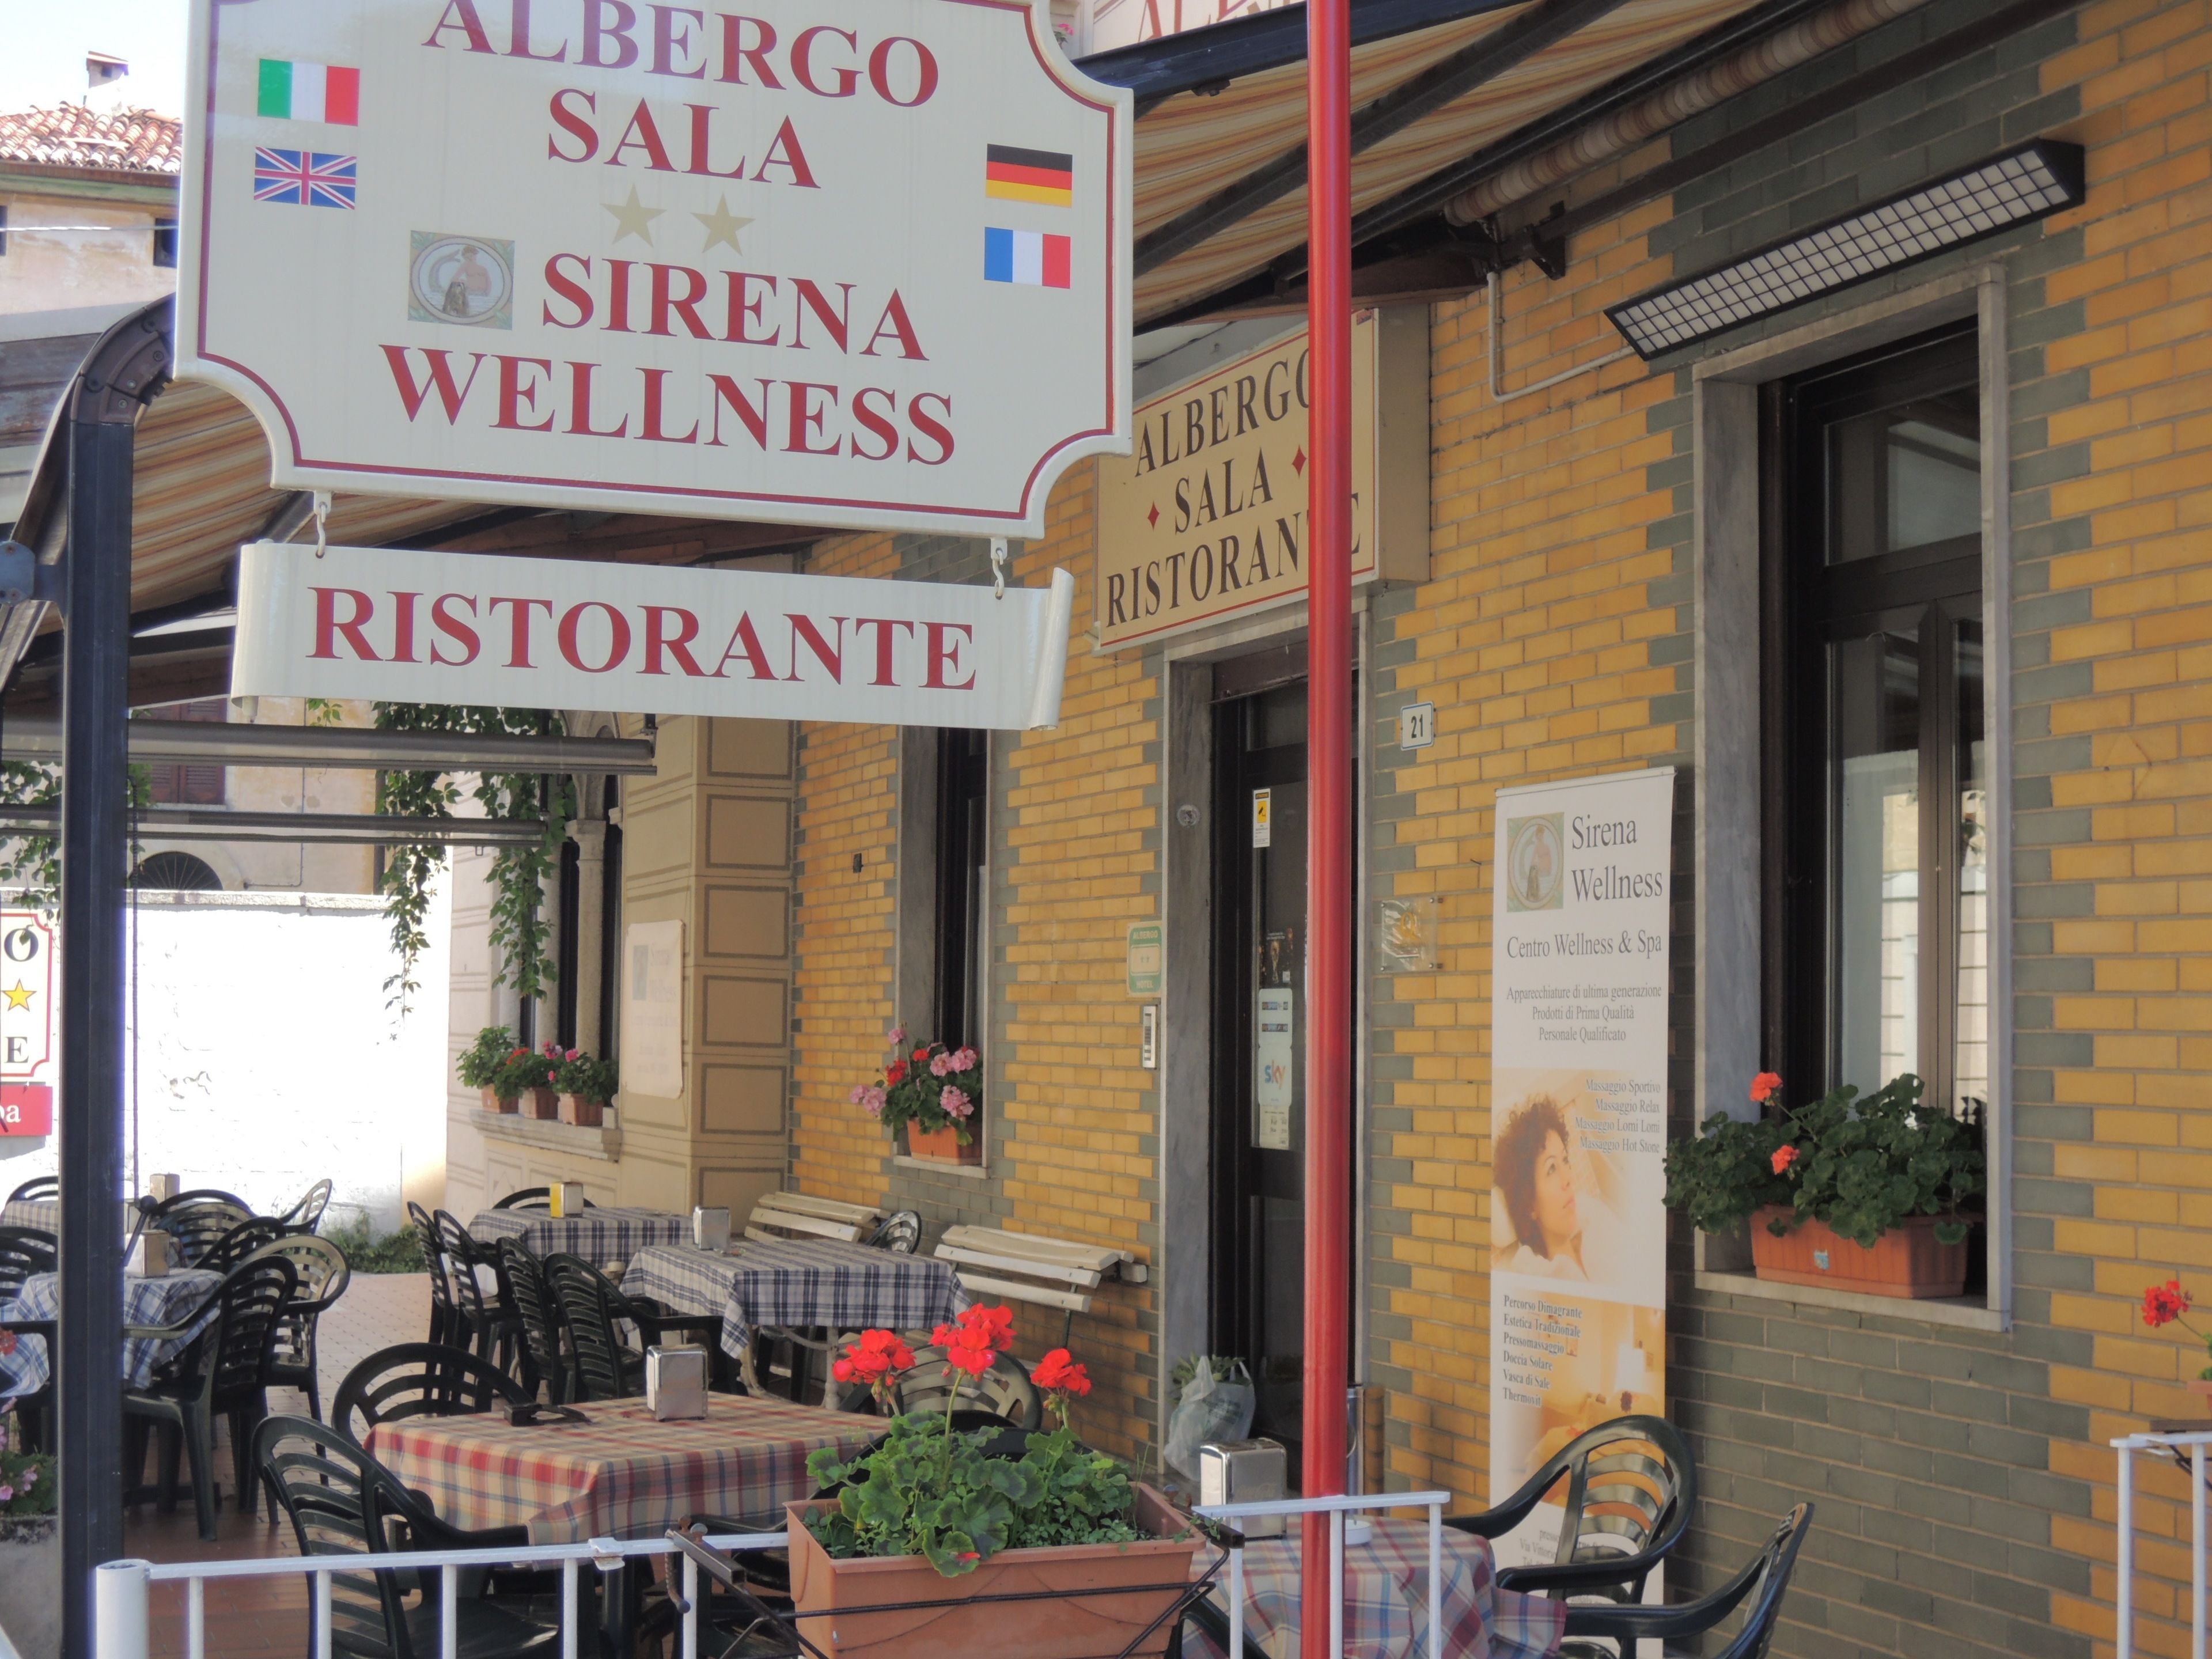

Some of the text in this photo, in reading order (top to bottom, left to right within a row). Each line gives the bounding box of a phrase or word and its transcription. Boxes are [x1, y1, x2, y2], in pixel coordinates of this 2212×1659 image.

[422, 0, 940, 107] ALBERGO
[547, 88, 821, 189] SALA
[541, 253, 930, 362] SIRENA
[378, 344, 956, 466] WELLNESS
[1175, 446, 1274, 535] SALA
[306, 586, 977, 691] RISTORANTE
[1411, 714, 1423, 738] 21
[1572, 815, 1637, 849] Sirena
[1571, 866, 1662, 902] Wellness
[1133, 930, 1158, 940] ALBERGO
[1507, 929, 1661, 959] Centro Wellness & Spa
[1137, 980, 1153, 988] HOTEL
[1506, 982, 1661, 1003] Apparecchiature di ultima generazione
[1532, 1005, 1634, 1022] Prodotti di Prima Qualità
[1539, 1027, 1626, 1043] Personale Qualificato
[1264, 1059, 1286, 1090] sky
[1586, 1078, 1661, 1096] Massaggio Sportivo
[1596, 1098, 1660, 1115] Massaggio Relax
[1575, 1117, 1660, 1134] Massaggio Lomi Lomi
[1580, 1136, 1659, 1153] Massaggio Hot Stone
[1504, 1295, 1582, 1319] Percorso Dimagrante
[1504, 1313, 1581, 1338] Estetica Tradizionale
[1504, 1332, 1564, 1355] Pressomassaggio
[1503, 1350, 1552, 1370] Doccia Solare
[1503, 1369, 1550, 1389] Vasca di Sale
[1503, 1388, 1541, 1406] Thermovit
[1520, 1538, 1530, 1551] Via
